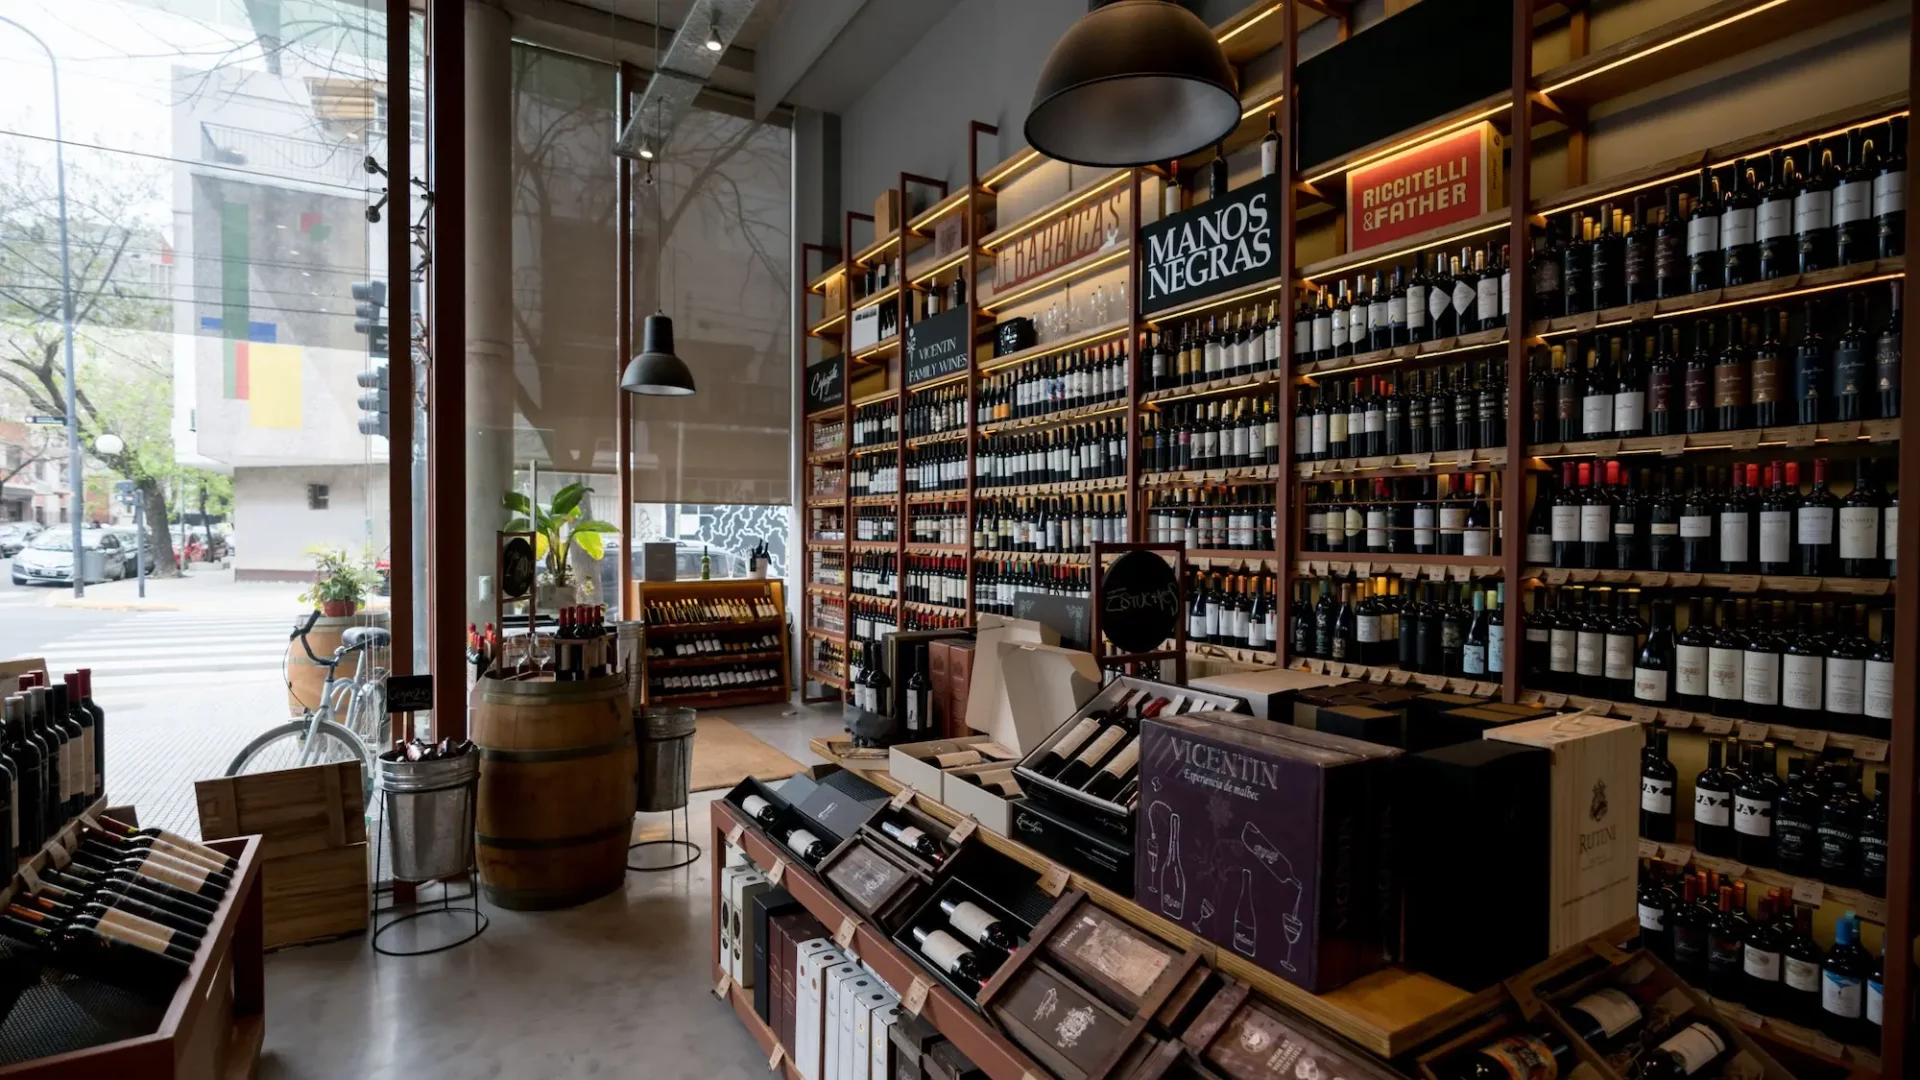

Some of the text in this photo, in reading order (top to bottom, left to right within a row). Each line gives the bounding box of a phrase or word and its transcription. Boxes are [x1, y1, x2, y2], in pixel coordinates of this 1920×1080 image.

[1362, 156, 1468, 207] RICCITELLI
[1149, 193, 1268, 266] MANOS
[1362, 182, 1467, 232] &FATHER
[1148, 228, 1272, 300] NEGRAS
[908, 352, 968, 383] FAMILY WINES
[918, 336, 957, 360] VICENTIN
[1170, 737, 1279, 790] VICENTIN
[1183, 768, 1260, 802] Experiencia de malbec
[1579, 824, 1617, 854] RUTINI
